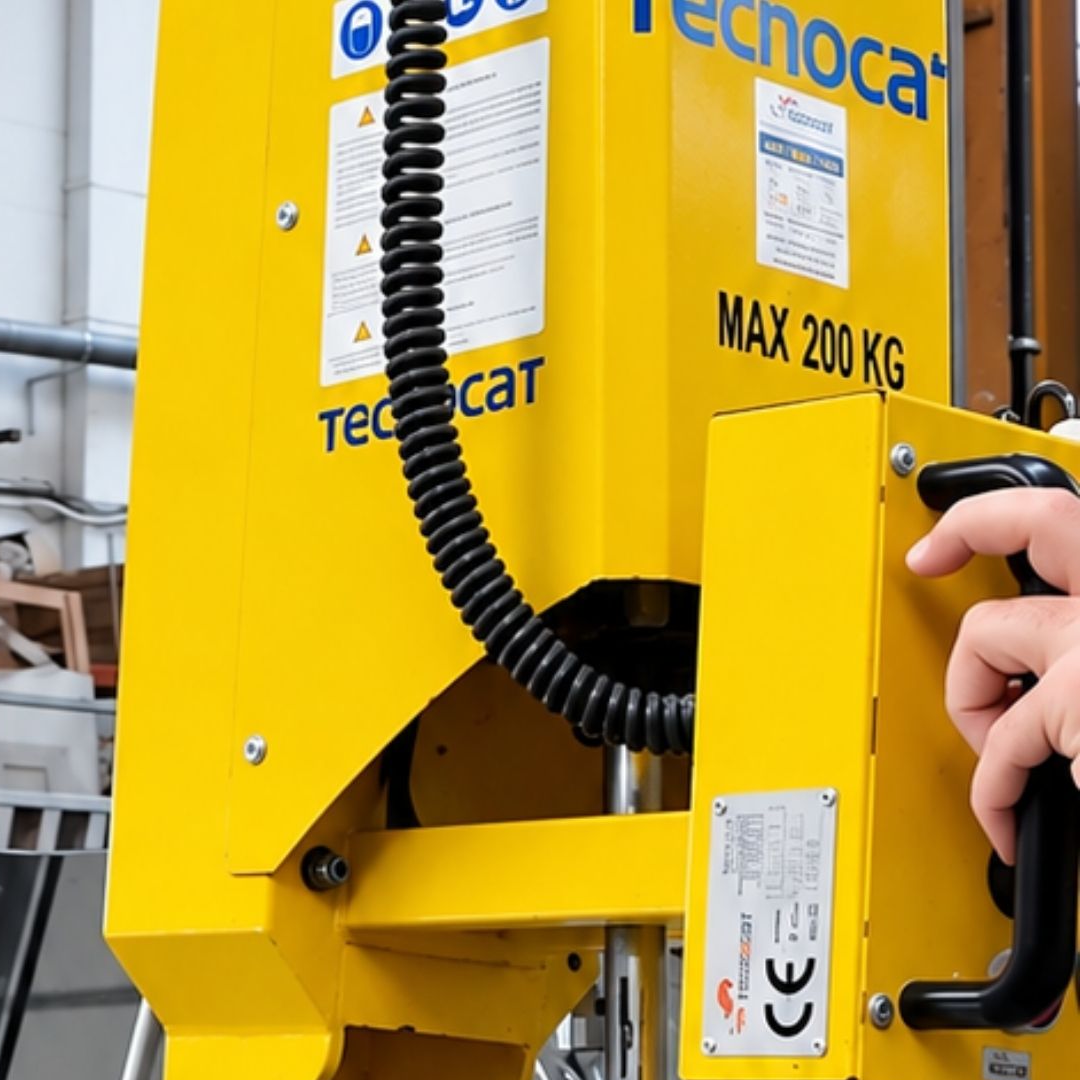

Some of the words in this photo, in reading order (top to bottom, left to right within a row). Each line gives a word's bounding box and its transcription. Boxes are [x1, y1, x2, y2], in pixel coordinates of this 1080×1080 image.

[634, 0, 946, 121] ecnoca
[718, 290, 789, 363] MAX
[802, 313, 853, 378] 200
[862, 328, 905, 391] KG
[318, 357, 545, 452] TeccaT
